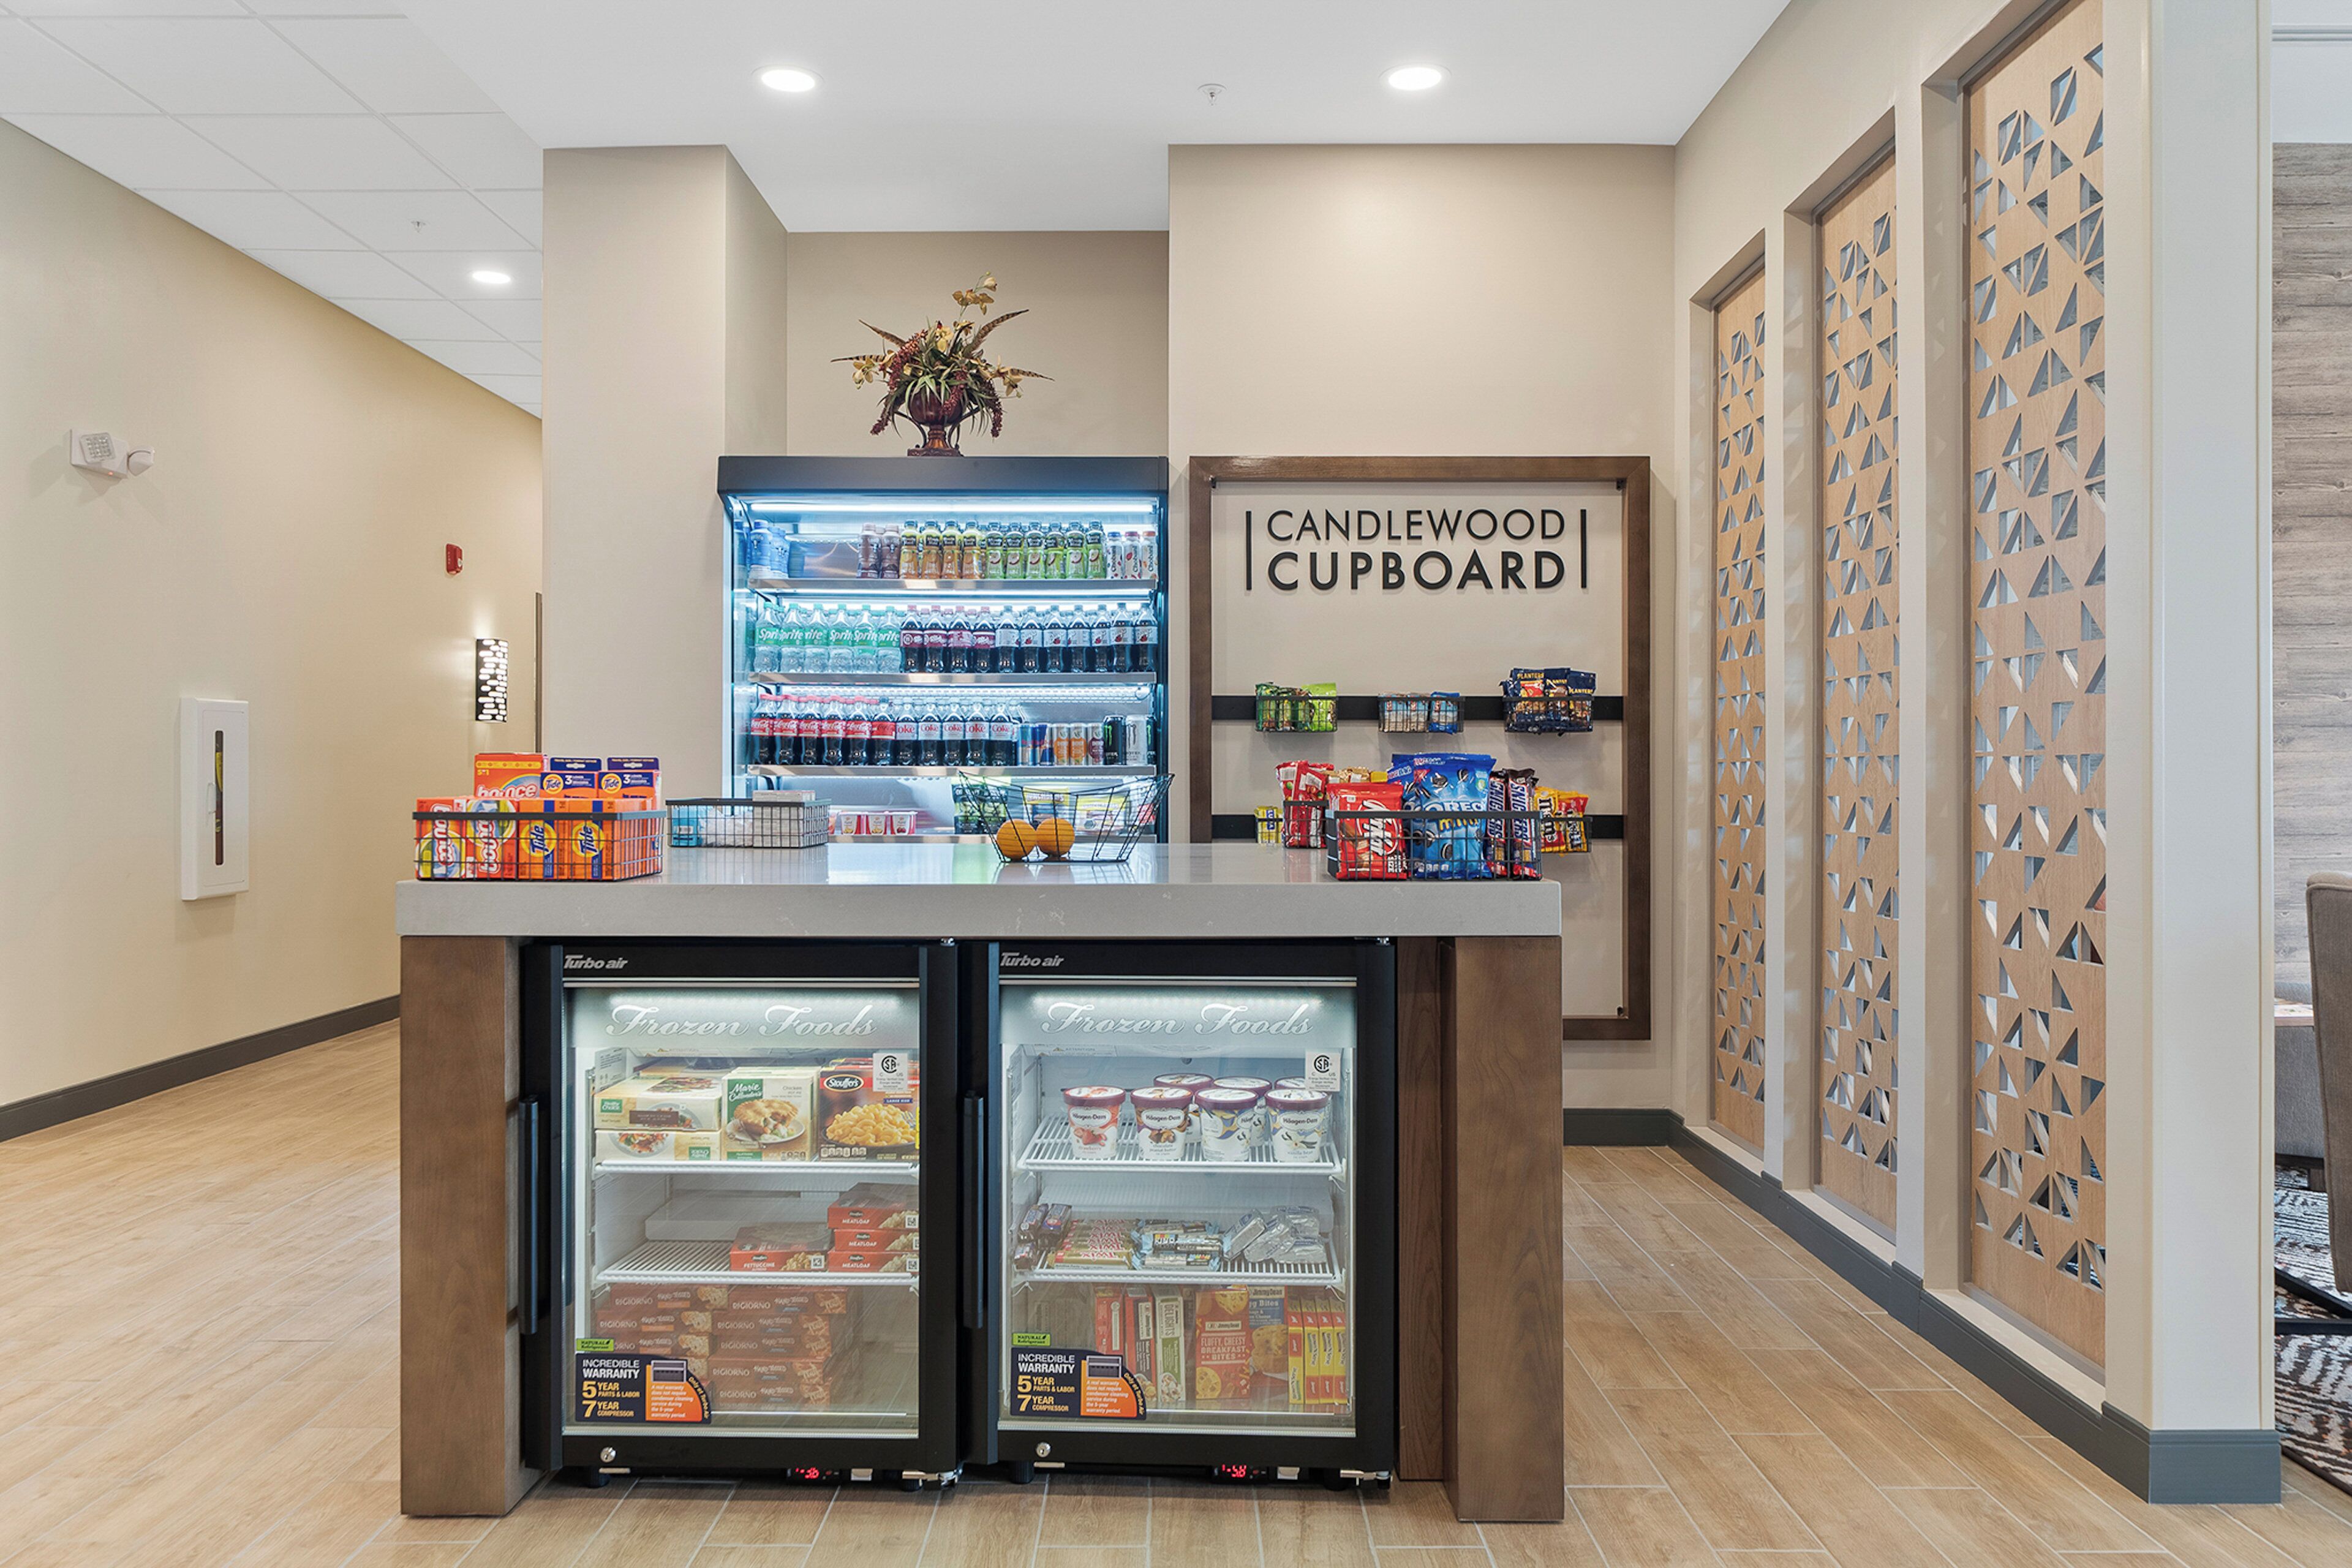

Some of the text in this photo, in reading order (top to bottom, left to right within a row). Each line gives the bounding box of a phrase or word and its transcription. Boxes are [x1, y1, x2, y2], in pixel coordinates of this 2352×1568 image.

[1267, 509, 1565, 541] CANDLEWOOD
[1267, 549, 1565, 590] CUPBOARD
[759, 628, 778, 640] Spri
[779, 630, 804, 641] prite
[804, 630, 823, 640] rite
[829, 629, 852, 641] Sprit
[879, 631, 900, 641] prite
[921, 723, 939, 732] Coke
[944, 723, 962, 733] Coke
[992, 723, 1010, 733] Coke
[545, 778, 560, 790] Tide
[565, 775, 572, 785] 3
[603, 778, 619, 790] Tide
[623, 774, 631, 784] 3
[1489, 780, 1506, 841] SNICERS
[1510, 783, 1529, 843] SNICERS
[478, 818, 498, 872] bounc
[530, 825, 549, 856] Tide
[579, 824, 598, 855] Tide
[564, 954, 628, 969] Turbo air
[1000, 952, 1064, 967] Turbo air
[606, 1005, 878, 1036] Frozen Foods
[1041, 1002, 1313, 1035] Frozen Foods
[729, 1083, 761, 1094] Marie
[1224, 1336, 1246, 1346] CHEESY
[583, 1359, 640, 1368] INCREDIBLE
[1018, 1354, 1075, 1363] INCREDIBLE
[583, 1368, 640, 1379] WARRANTY
[1018, 1363, 1075, 1374] WARRANTY
[582, 1381, 619, 1398] 5 YEAR
[1017, 1375, 1054, 1393] 5 YEAR
[582, 1400, 597, 1417] 7
[1017, 1395, 1031, 1411] 7
